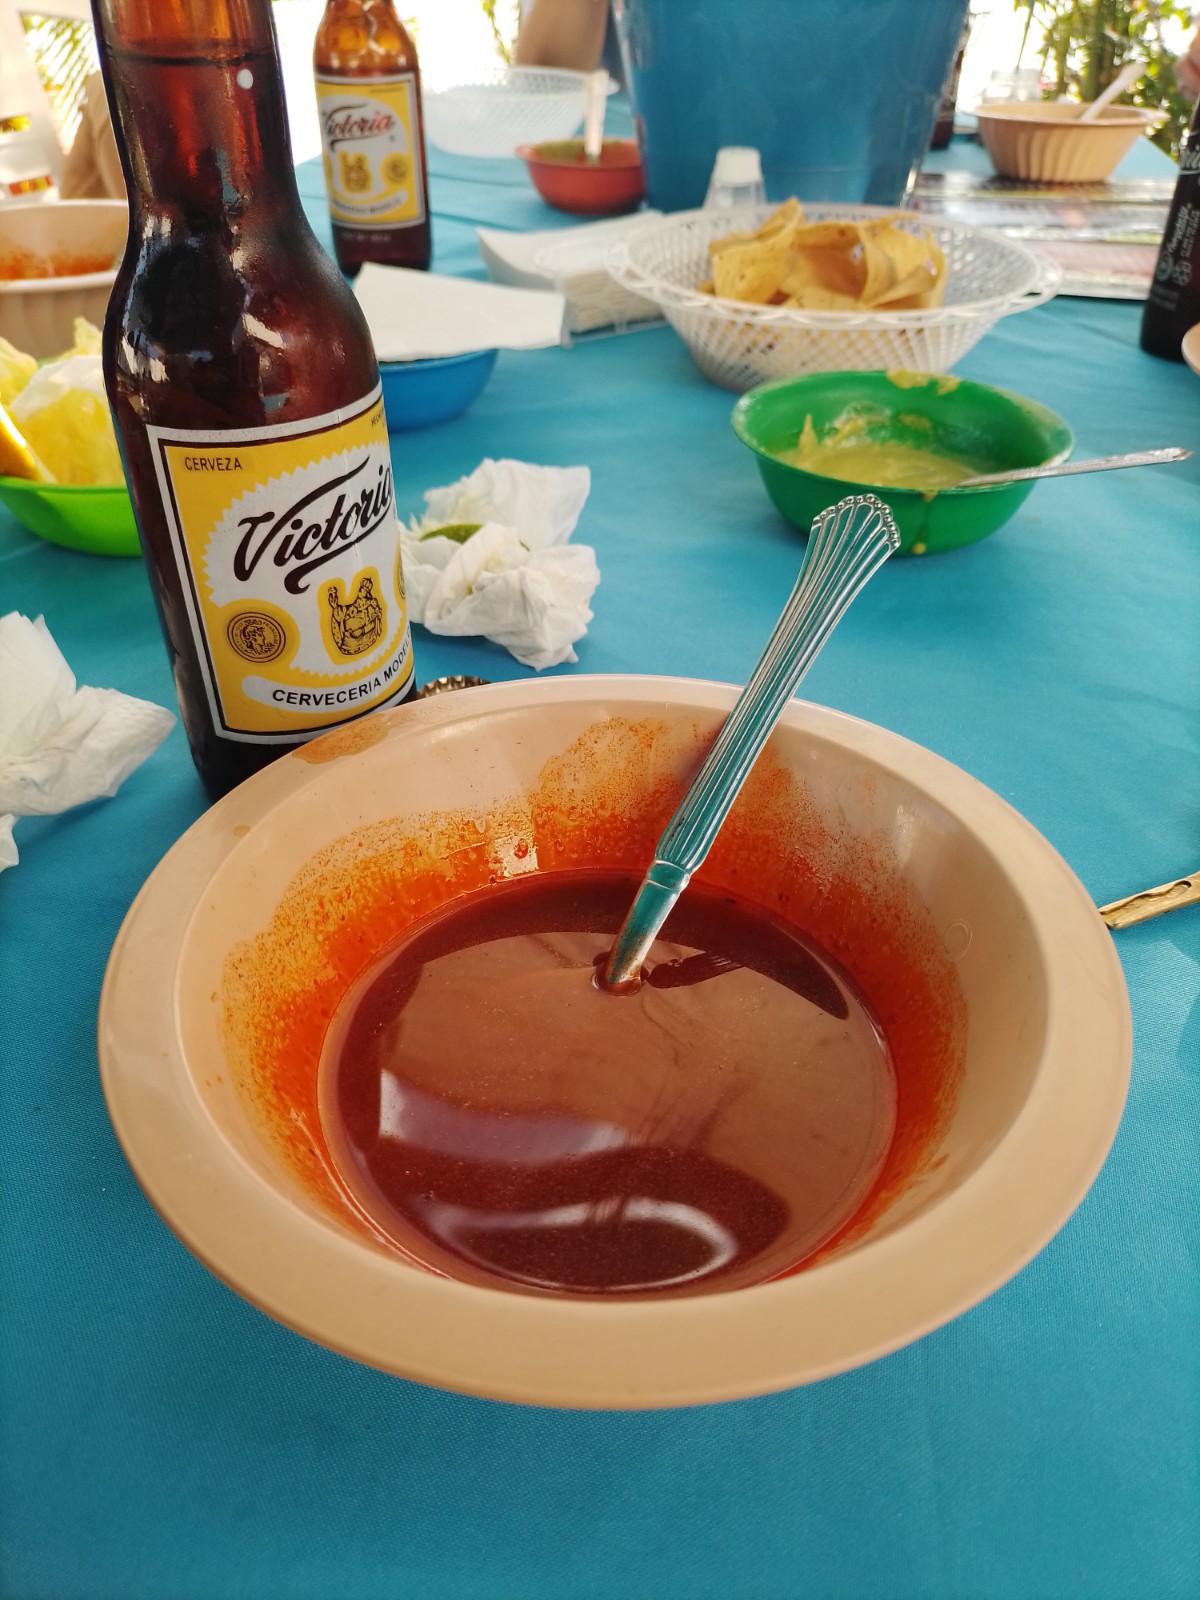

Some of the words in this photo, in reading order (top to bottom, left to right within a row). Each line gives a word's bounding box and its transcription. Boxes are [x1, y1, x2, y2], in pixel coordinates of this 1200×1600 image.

[184, 456, 243, 472] CERVEZA
[233, 454, 392, 595] Victoria
[272, 676, 382, 706] CERVECERIA
